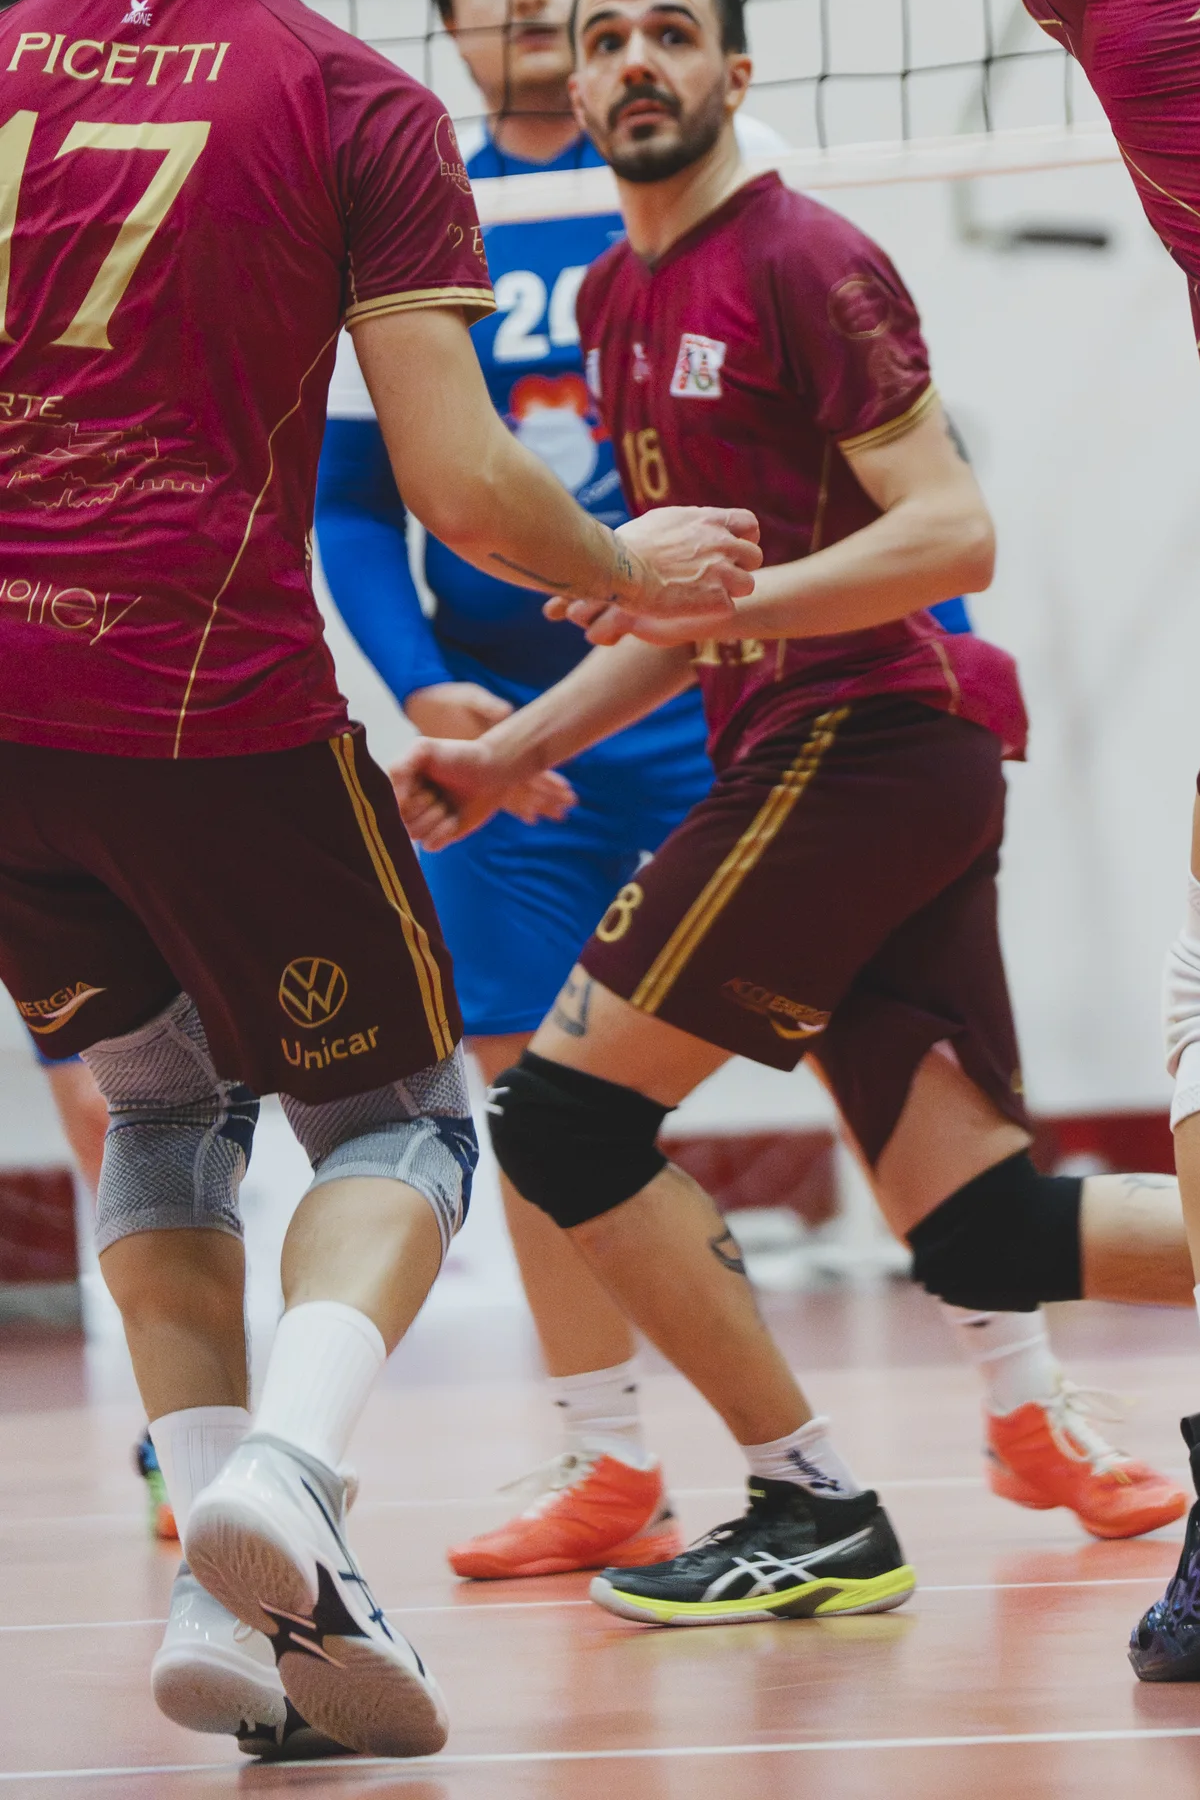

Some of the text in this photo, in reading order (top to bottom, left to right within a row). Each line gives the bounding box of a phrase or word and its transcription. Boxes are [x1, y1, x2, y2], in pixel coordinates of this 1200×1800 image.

[6, 32, 231, 86] PICETTI
[0, 109, 212, 350] 17
[281, 1025, 379, 1070] Unicar
